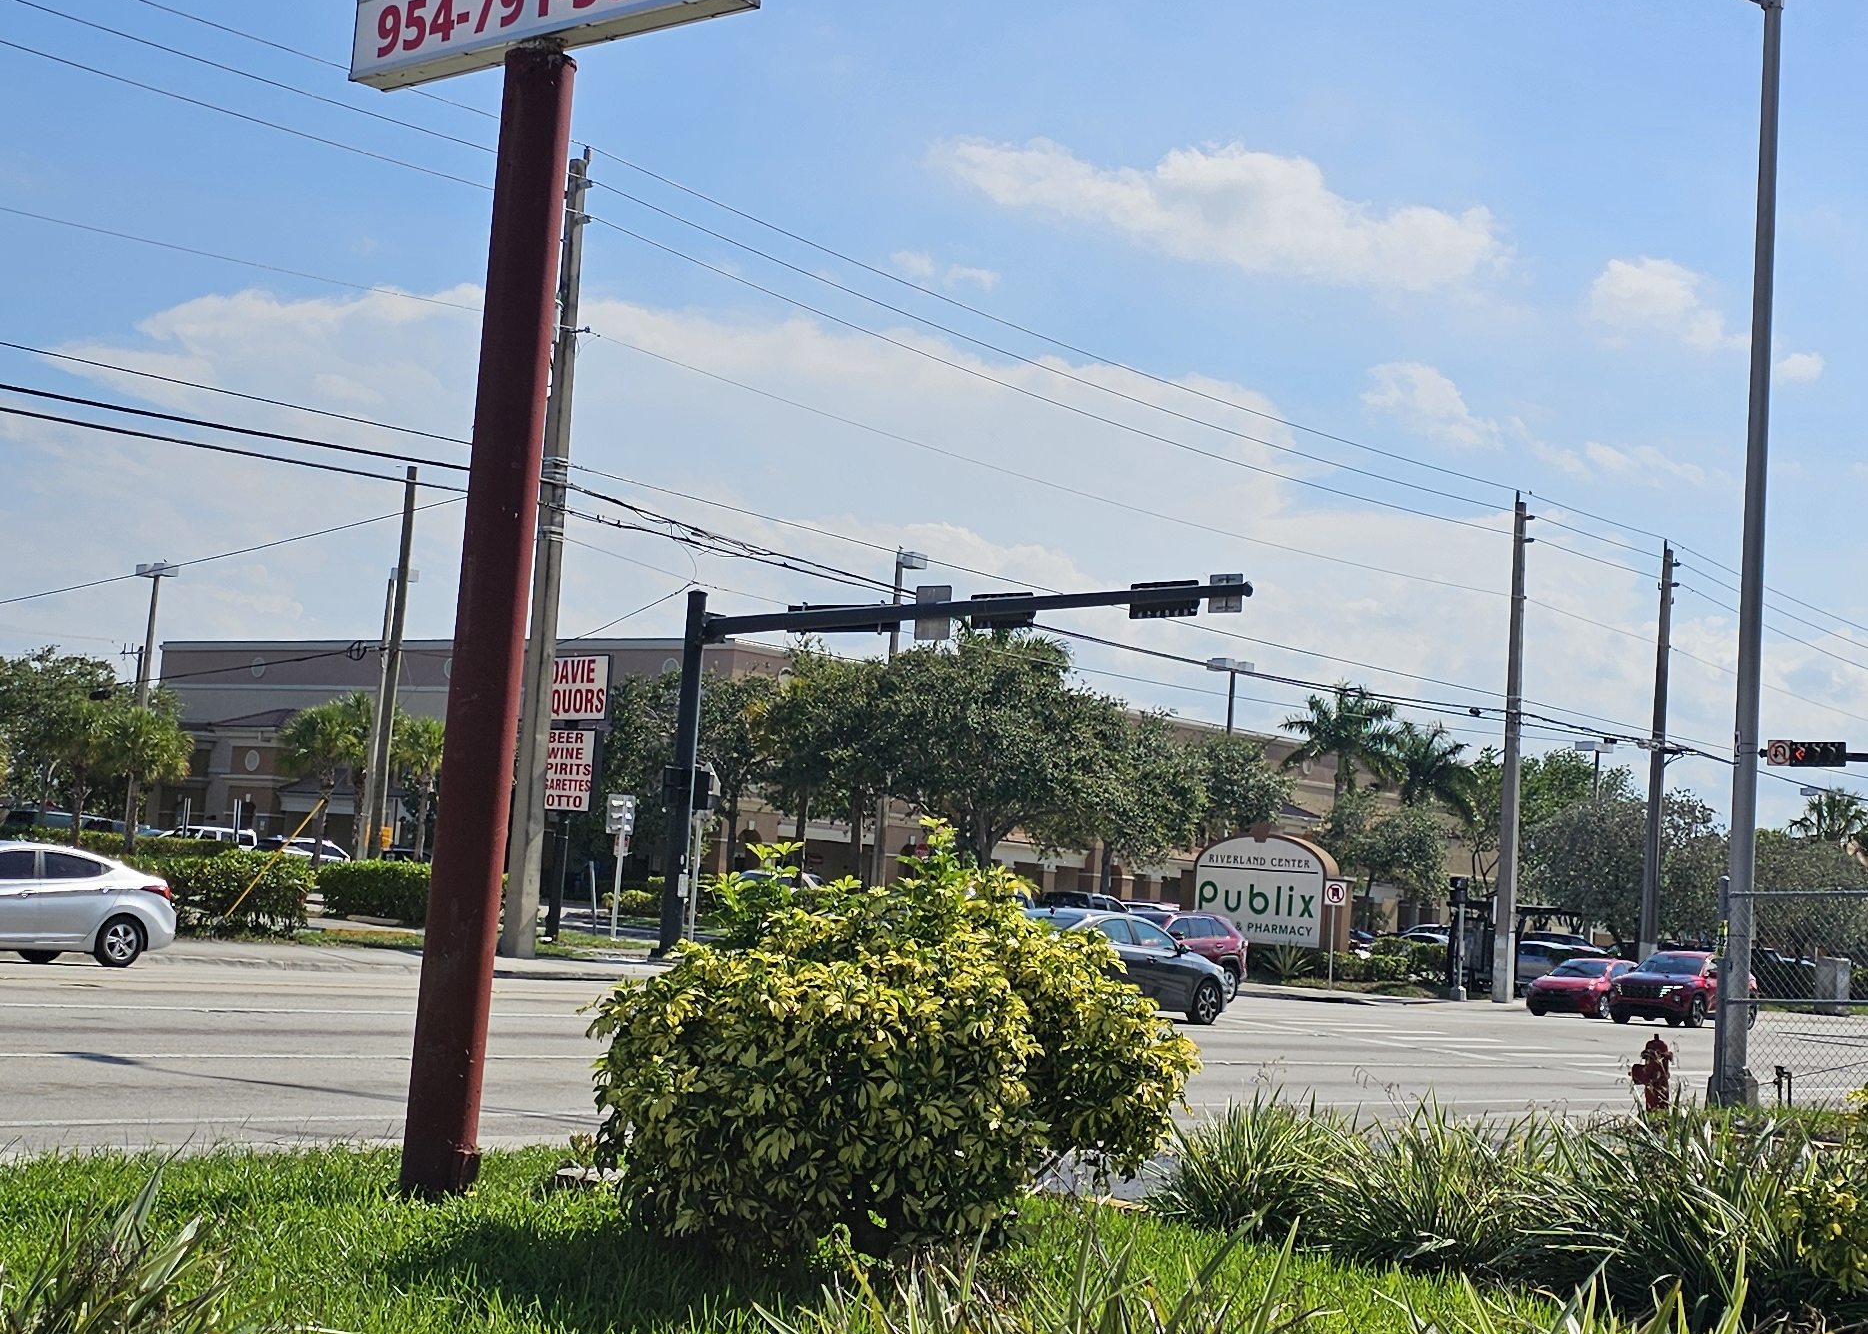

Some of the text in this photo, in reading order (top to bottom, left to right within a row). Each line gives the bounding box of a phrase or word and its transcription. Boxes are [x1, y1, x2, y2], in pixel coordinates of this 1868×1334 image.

[551, 688, 604, 716] QUORS
[549, 732, 584, 743] BEER
[548, 747, 584, 760] WINE
[547, 763, 591, 776] PIRITS
[545, 778, 591, 792] GARETTES
[546, 794, 582, 808] OTTO
[1209, 854, 1310, 869] RIVERLAND CENTER
[1199, 880, 1314, 918] Publix
[1236, 922, 1312, 937] & PHARMACY
